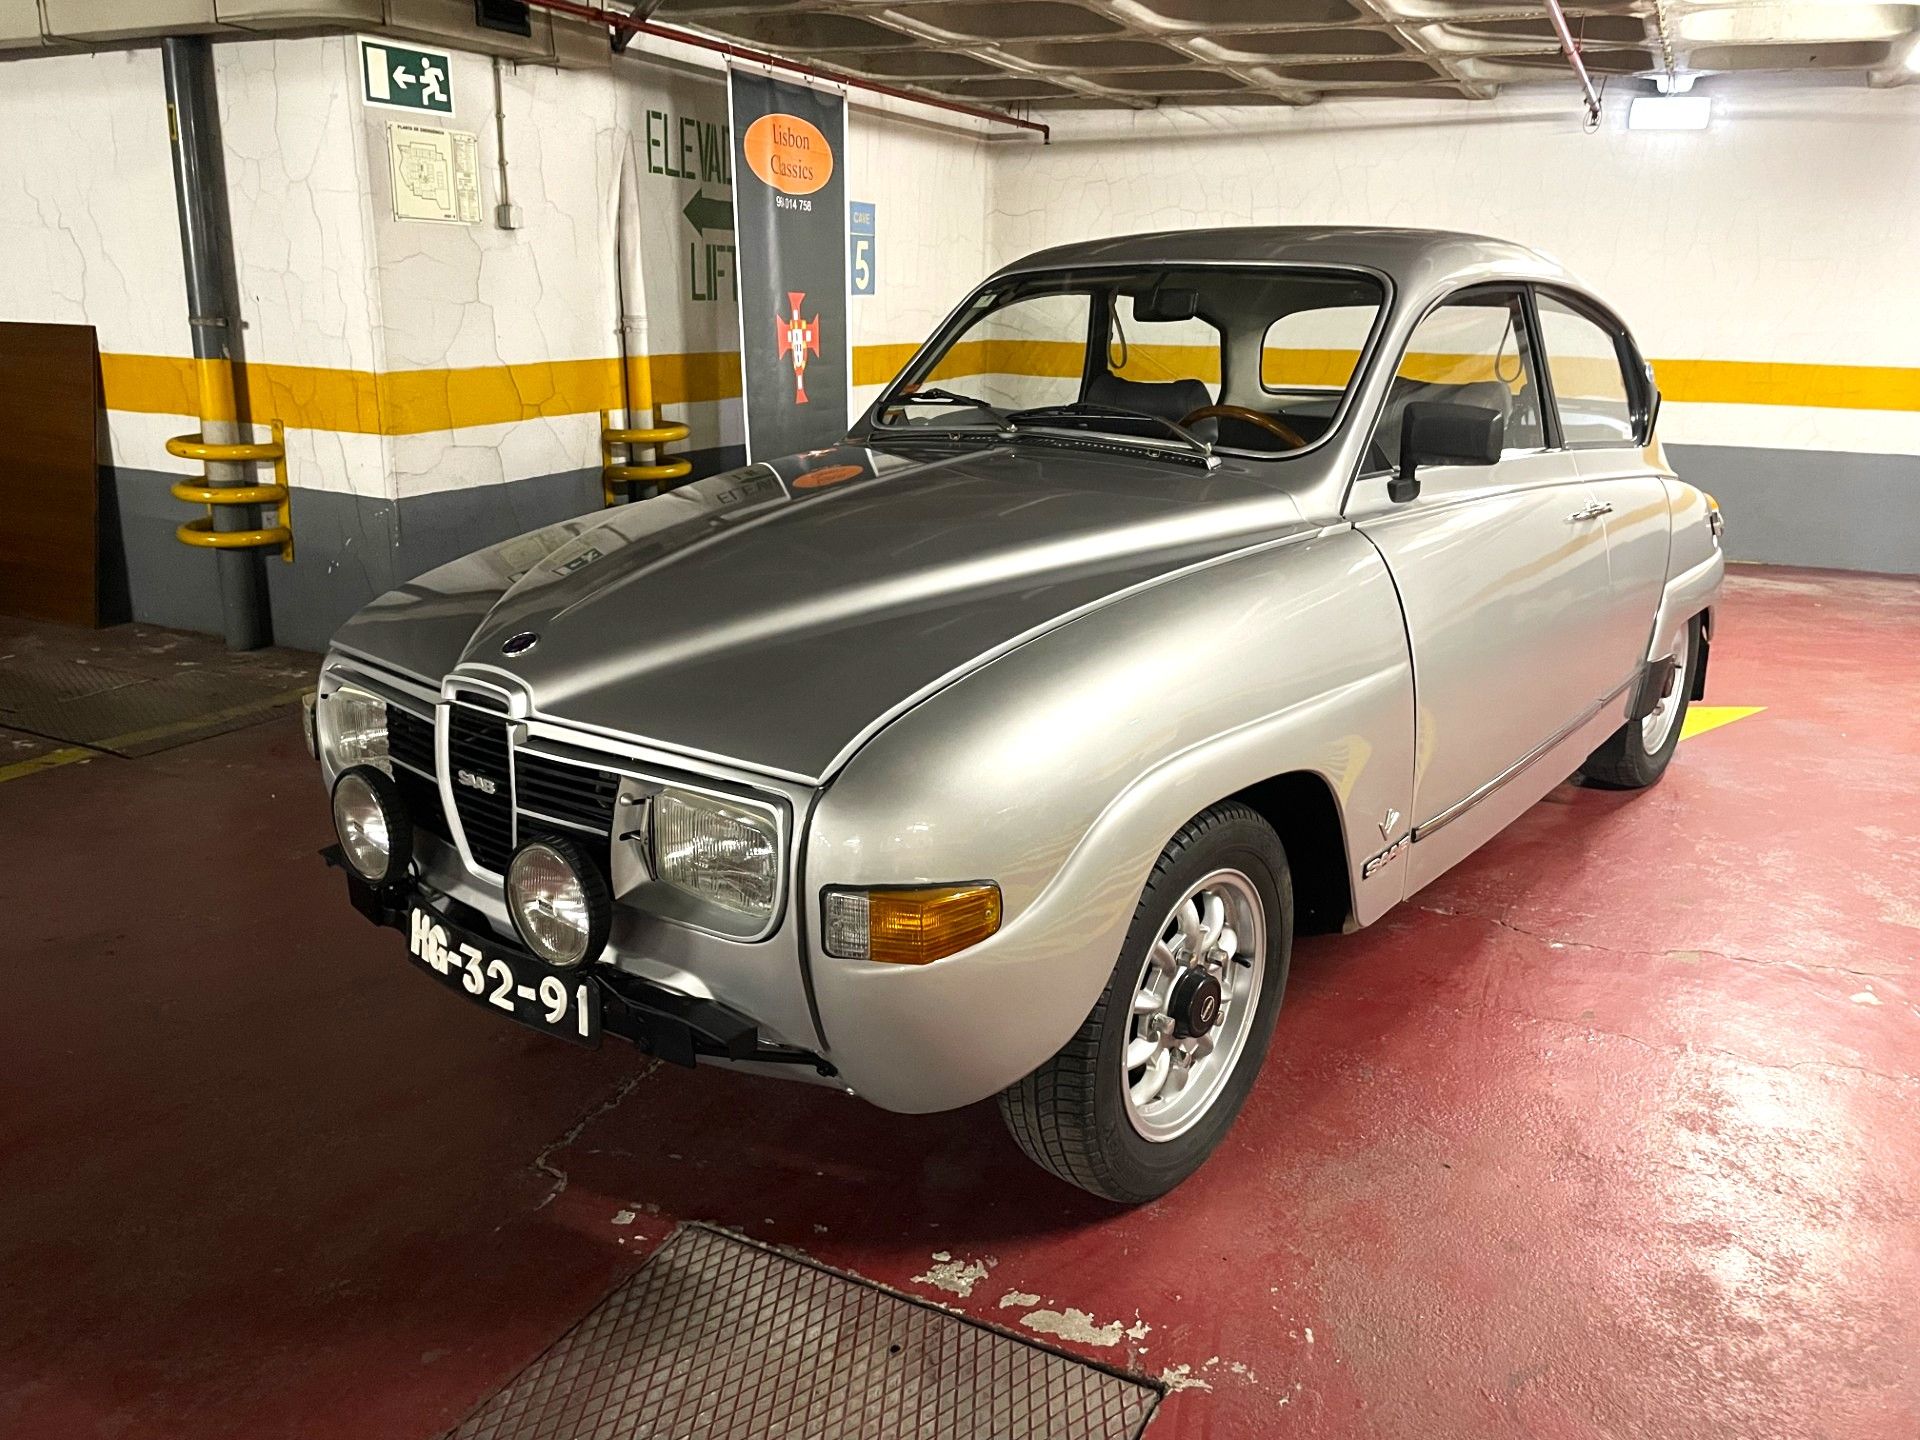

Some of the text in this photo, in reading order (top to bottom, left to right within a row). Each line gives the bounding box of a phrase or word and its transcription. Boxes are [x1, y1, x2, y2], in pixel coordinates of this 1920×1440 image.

[772, 124, 810, 150] Lisbon
[770, 153, 814, 180] Classics
[856, 240, 870, 290] 5
[458, 769, 496, 795] SAAB
[411, 907, 589, 1037] HG-32-91
